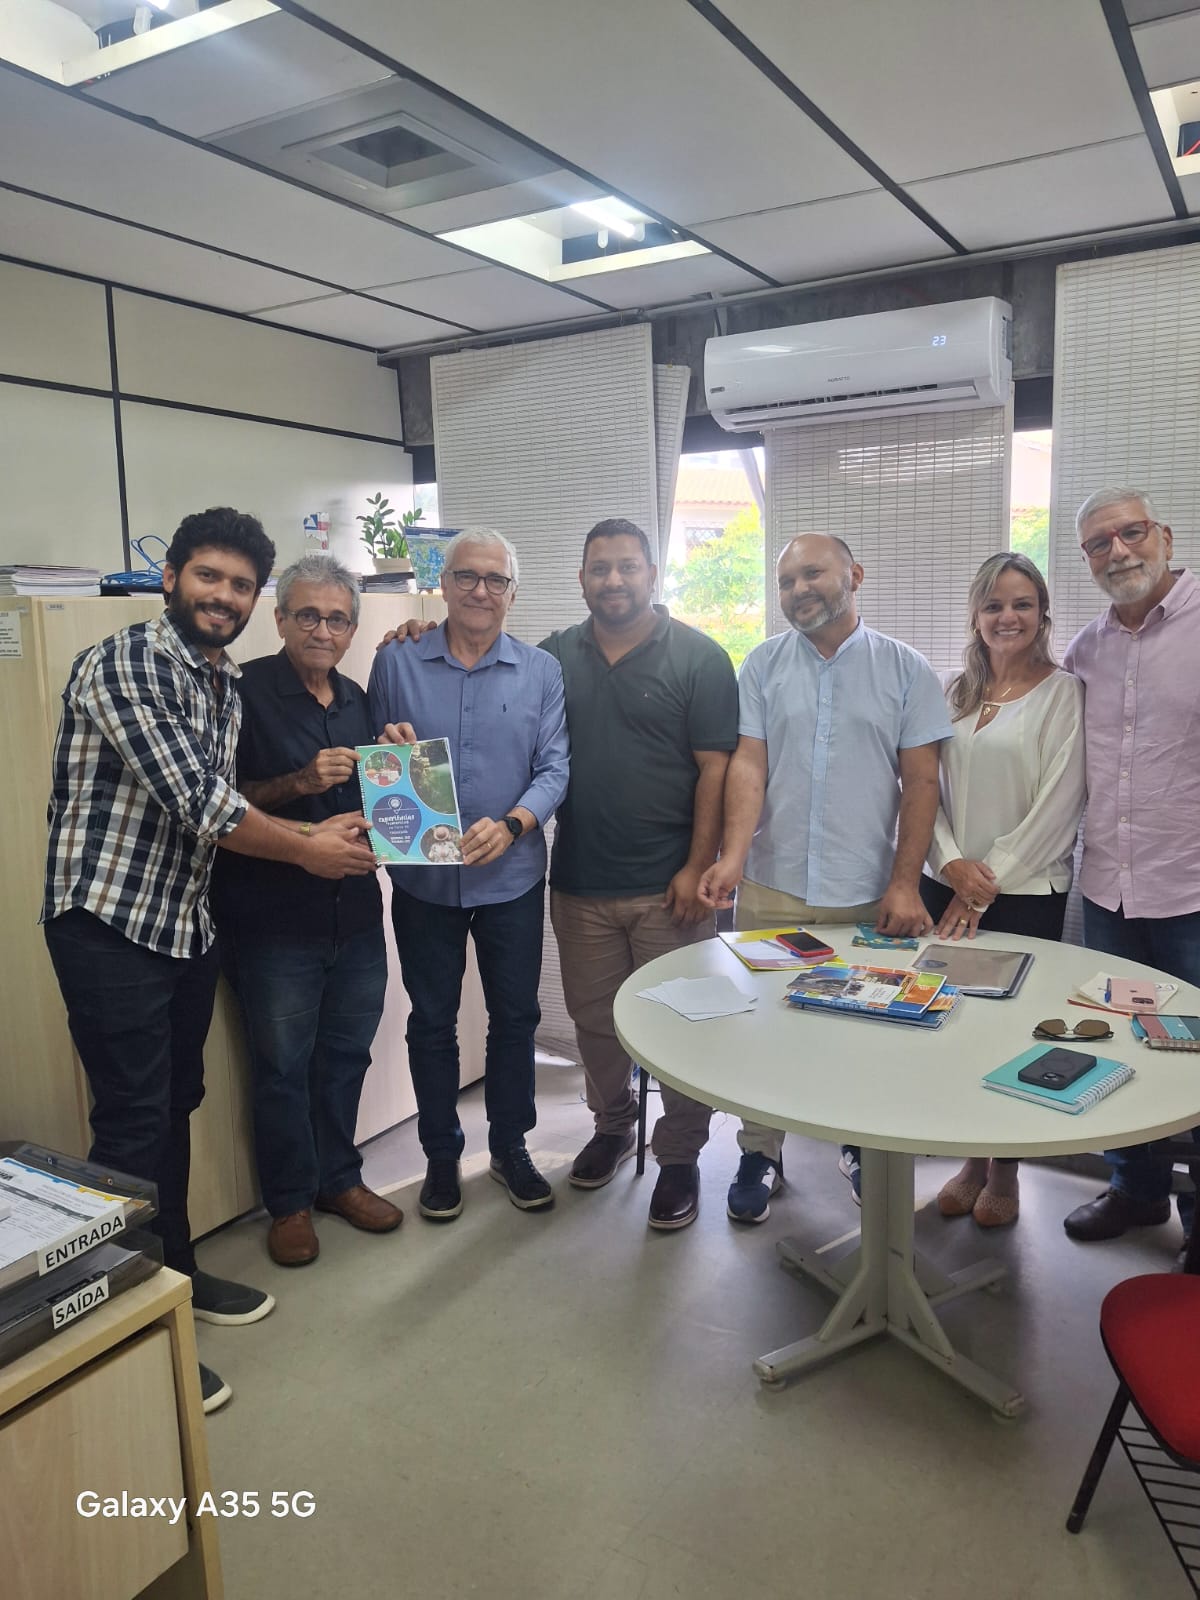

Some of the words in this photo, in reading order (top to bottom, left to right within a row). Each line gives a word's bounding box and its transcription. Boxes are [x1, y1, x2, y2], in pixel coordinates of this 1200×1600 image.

[932, 335, 947, 346] 23
[45, 1215, 123, 1268] ENTRADA
[55, 1286, 105, 1324] SAÍDA
